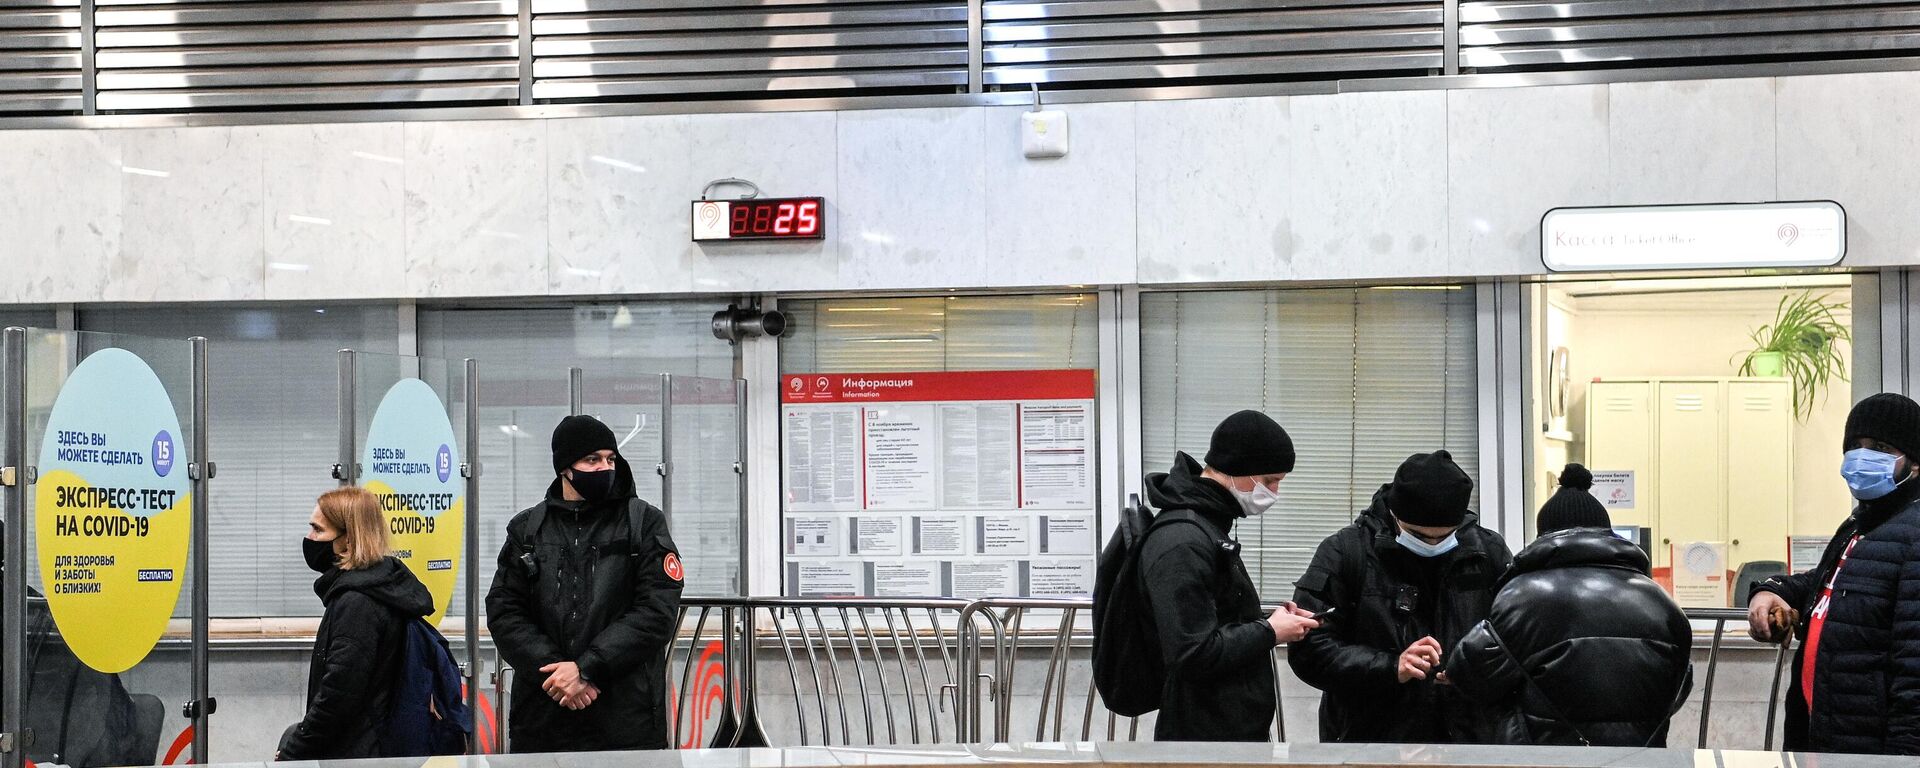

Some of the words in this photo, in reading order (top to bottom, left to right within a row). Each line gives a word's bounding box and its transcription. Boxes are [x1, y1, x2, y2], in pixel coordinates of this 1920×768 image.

[1555, 230, 1615, 247] Касса
[842, 377, 913, 390] Информация
[57, 430, 89, 447] ЗДЕСЬ
[91, 432, 106, 446] ВЫ
[57, 448, 99, 463] МОЖЕТЕ
[101, 450, 143, 466] СДЕЛАТЬ
[157, 440, 170, 460] 15
[372, 448, 394, 460] ЗДЕСЬ
[395, 449, 406, 460] ВЫ
[372, 462, 400, 474] МОЖЕТЕ
[401, 463, 431, 475] СДЕЛАТЬ
[439, 452, 449, 469] 15
[56, 485, 176, 510] ЭКСПРЕСС-ТЕСТ
[374, 493, 453, 511] КСПРЕСС-ТЕСТ
[55, 514, 79, 536] НА
[83, 515, 149, 537] COVID-19
[390, 516, 435, 535] COVID-19
[54, 555, 72, 568] ДЛЯ
[73, 555, 115, 568] ЗДОРОВЬЯ
[54, 570, 61, 580] И
[62, 569, 96, 580] ЗАБОТЫ
[138, 571, 172, 580] БЕСПЛАТНО
[54, 584, 61, 594] О
[62, 583, 101, 593] БЛИЗКИХ!
